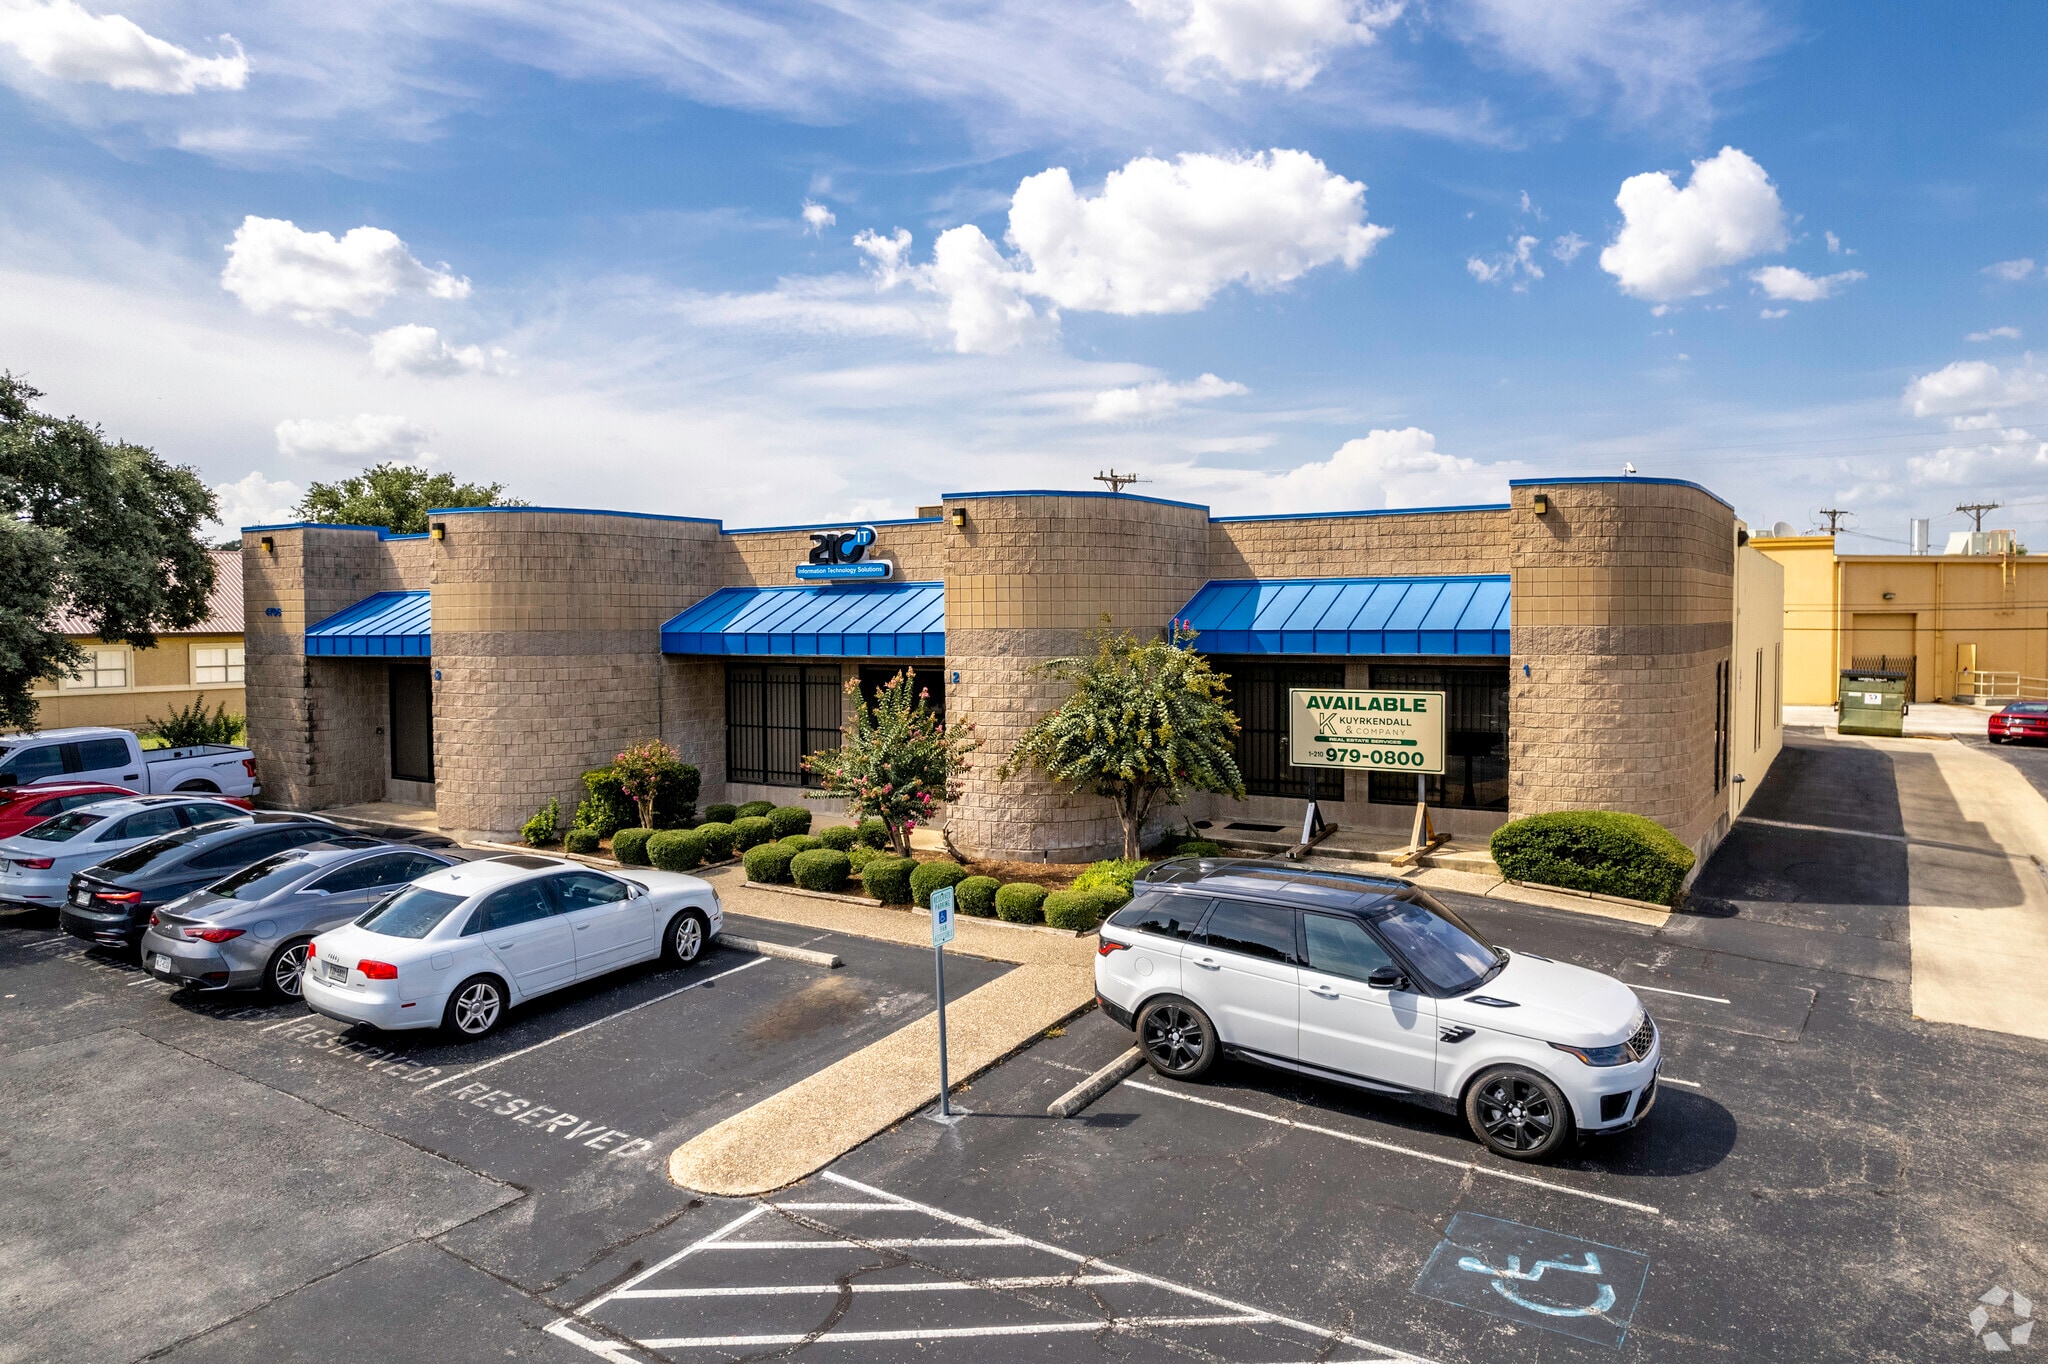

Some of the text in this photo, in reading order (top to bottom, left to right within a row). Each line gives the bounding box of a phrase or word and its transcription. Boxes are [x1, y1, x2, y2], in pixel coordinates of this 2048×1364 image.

[857, 531, 868, 542] IT
[953, 672, 960, 683] 2
[1306, 695, 1427, 713] AVAILABLE
[1339, 716, 1412, 727] KUYRKENDALL
[1345, 725, 1406, 736] & COMPANY
[1326, 747, 1424, 766] 979-0800
[449, 1081, 654, 1158] RESERVED
